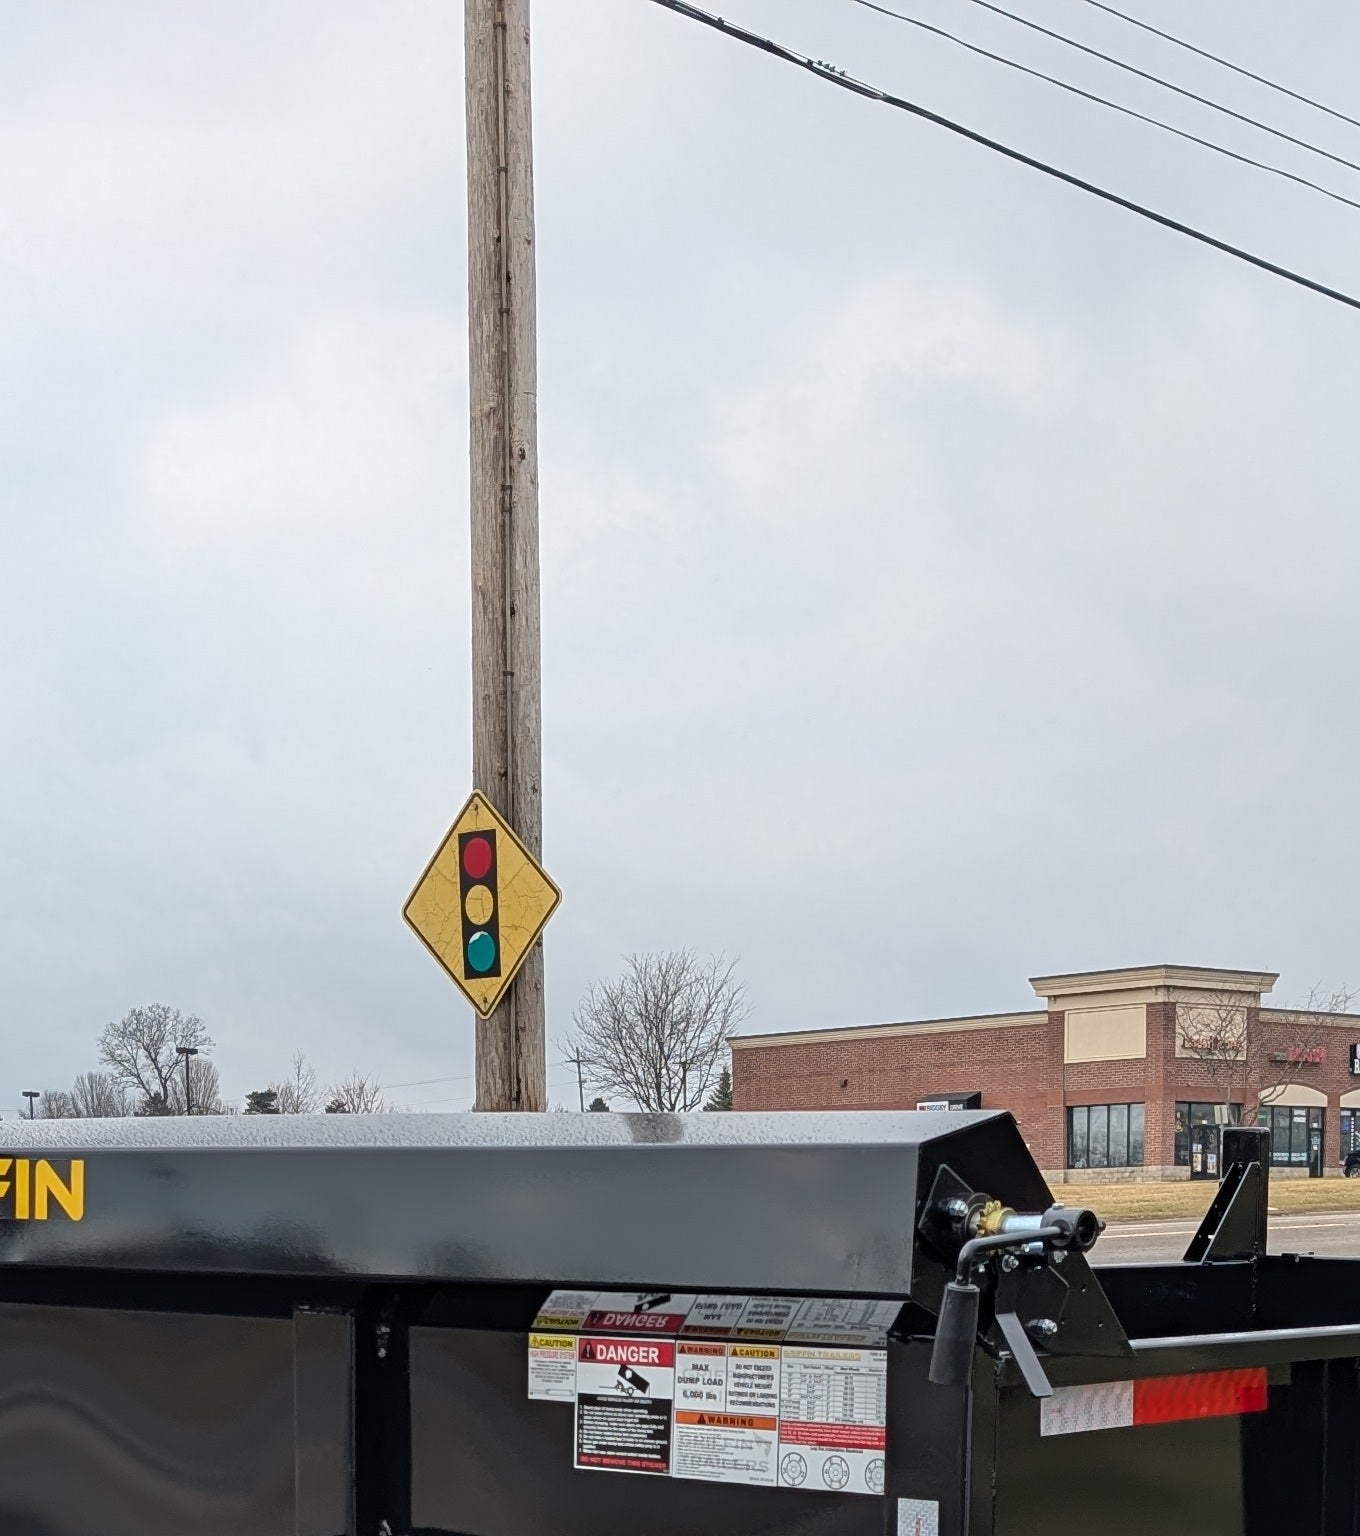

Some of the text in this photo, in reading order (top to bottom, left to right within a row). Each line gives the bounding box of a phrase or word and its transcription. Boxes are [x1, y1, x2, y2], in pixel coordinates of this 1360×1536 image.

[540, 1339, 573, 1348] CAUTION
[596, 1344, 660, 1364] DANGER
[687, 1346, 723, 1356] WARNING
[740, 1349, 775, 1358] CAUTION
[691, 1363, 709, 1371] MAX
[677, 1376, 724, 1387] DUMP LOAD
[708, 1415, 755, 1427] WARNING
